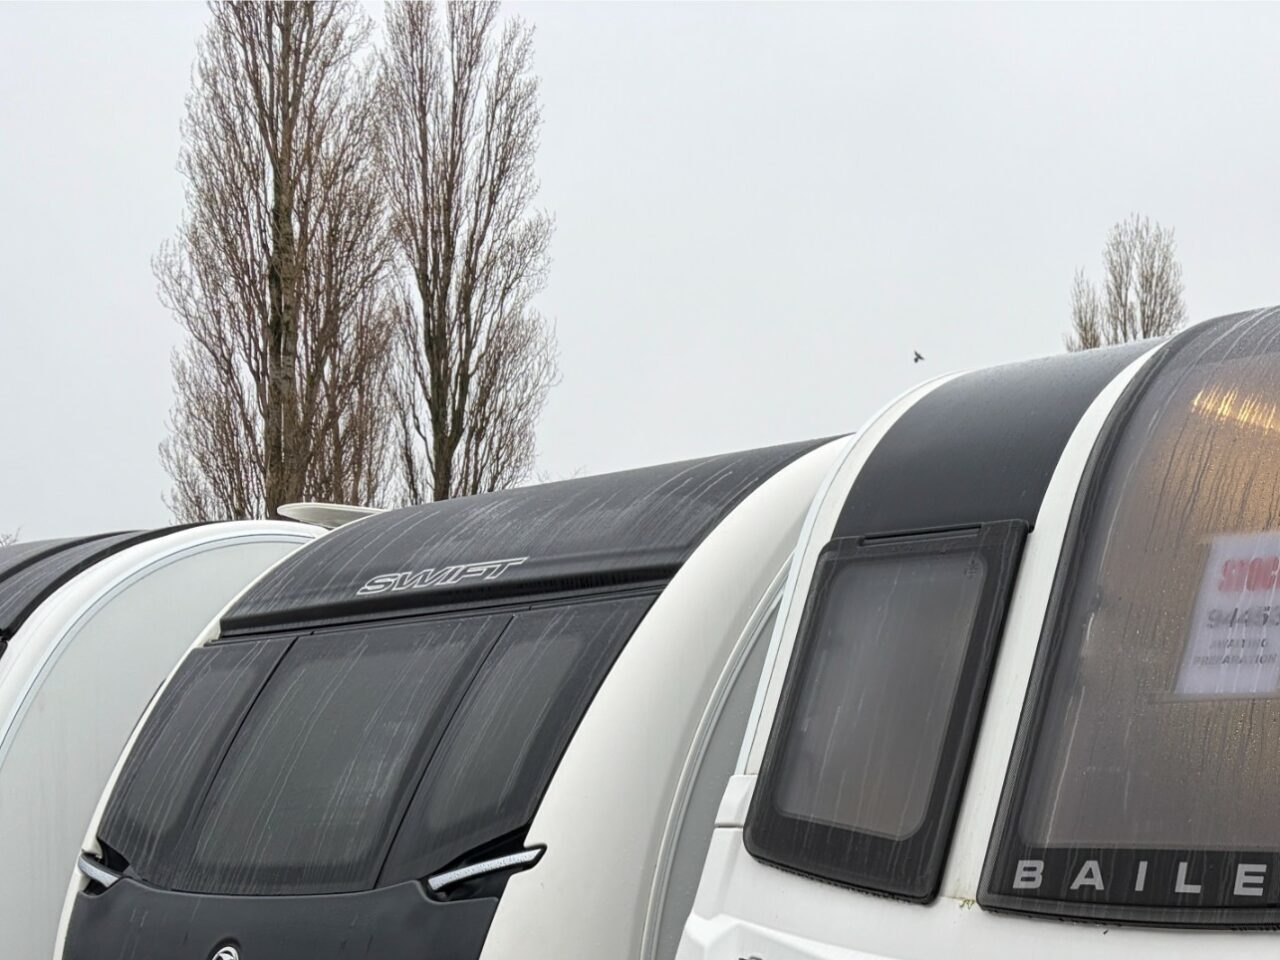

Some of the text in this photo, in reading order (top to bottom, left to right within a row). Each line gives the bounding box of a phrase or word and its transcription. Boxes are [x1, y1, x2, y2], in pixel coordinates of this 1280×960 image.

[356, 556, 529, 595] SWIFT
[1209, 638, 1269, 649] AWAITING
[1193, 654, 1277, 666] PREPARATION
